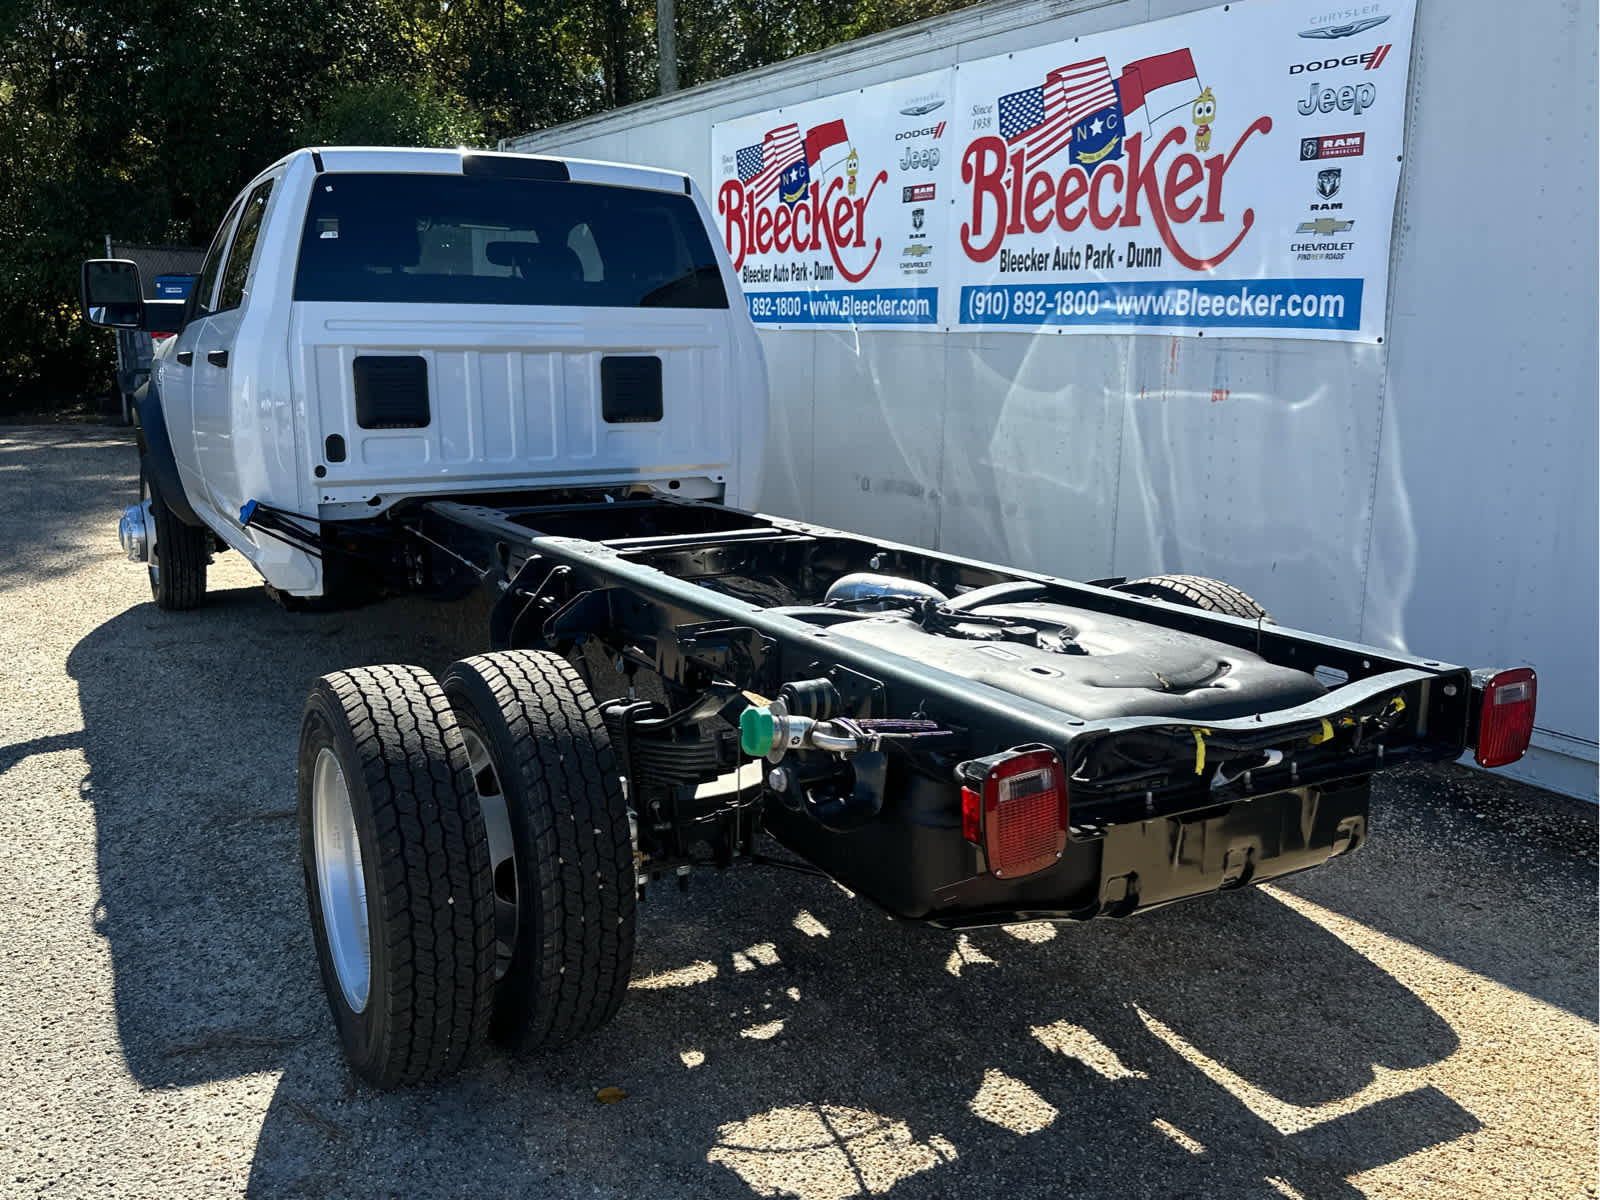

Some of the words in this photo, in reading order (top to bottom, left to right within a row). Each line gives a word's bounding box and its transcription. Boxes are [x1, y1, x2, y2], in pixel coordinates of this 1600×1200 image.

[1309, 4, 1380, 25] CHRYSLER
[1289, 52, 1377, 75] DODGE
[1297, 82, 1377, 116] Jeep
[971, 104, 993, 117] Since
[895, 127, 939, 140] DODGE
[972, 117, 992, 130] 1938
[1077, 126, 1088, 142] N
[1106, 114, 1118, 130] C
[1323, 137, 1361, 148] RAM
[899, 146, 940, 171] Jeep
[960, 116, 1273, 271] Bleecker
[1310, 202, 1343, 211] RAM
[718, 170, 888, 283] Bleecker
[1000, 247, 1049, 273] Bleecker
[1052, 245, 1081, 271] Auto
[1085, 243, 1115, 270] Park
[1127, 241, 1162, 268] Dunn
[1290, 242, 1355, 251] CHEVROLET
[742, 264, 773, 283] Bleecker
[773, 263, 790, 282] Auto
[791, 262, 808, 281] Park
[814, 261, 834, 280] Dunn
[899, 261, 932, 269] CHEVROLET
[752, 296, 801, 317] 892-1800
[811, 294, 930, 317] www.Bleecker.com
[969, 288, 1010, 320] (910)
[1013, 290, 1100, 316] 892-1800
[1116, 287, 1345, 318] www.Bleecker.com
